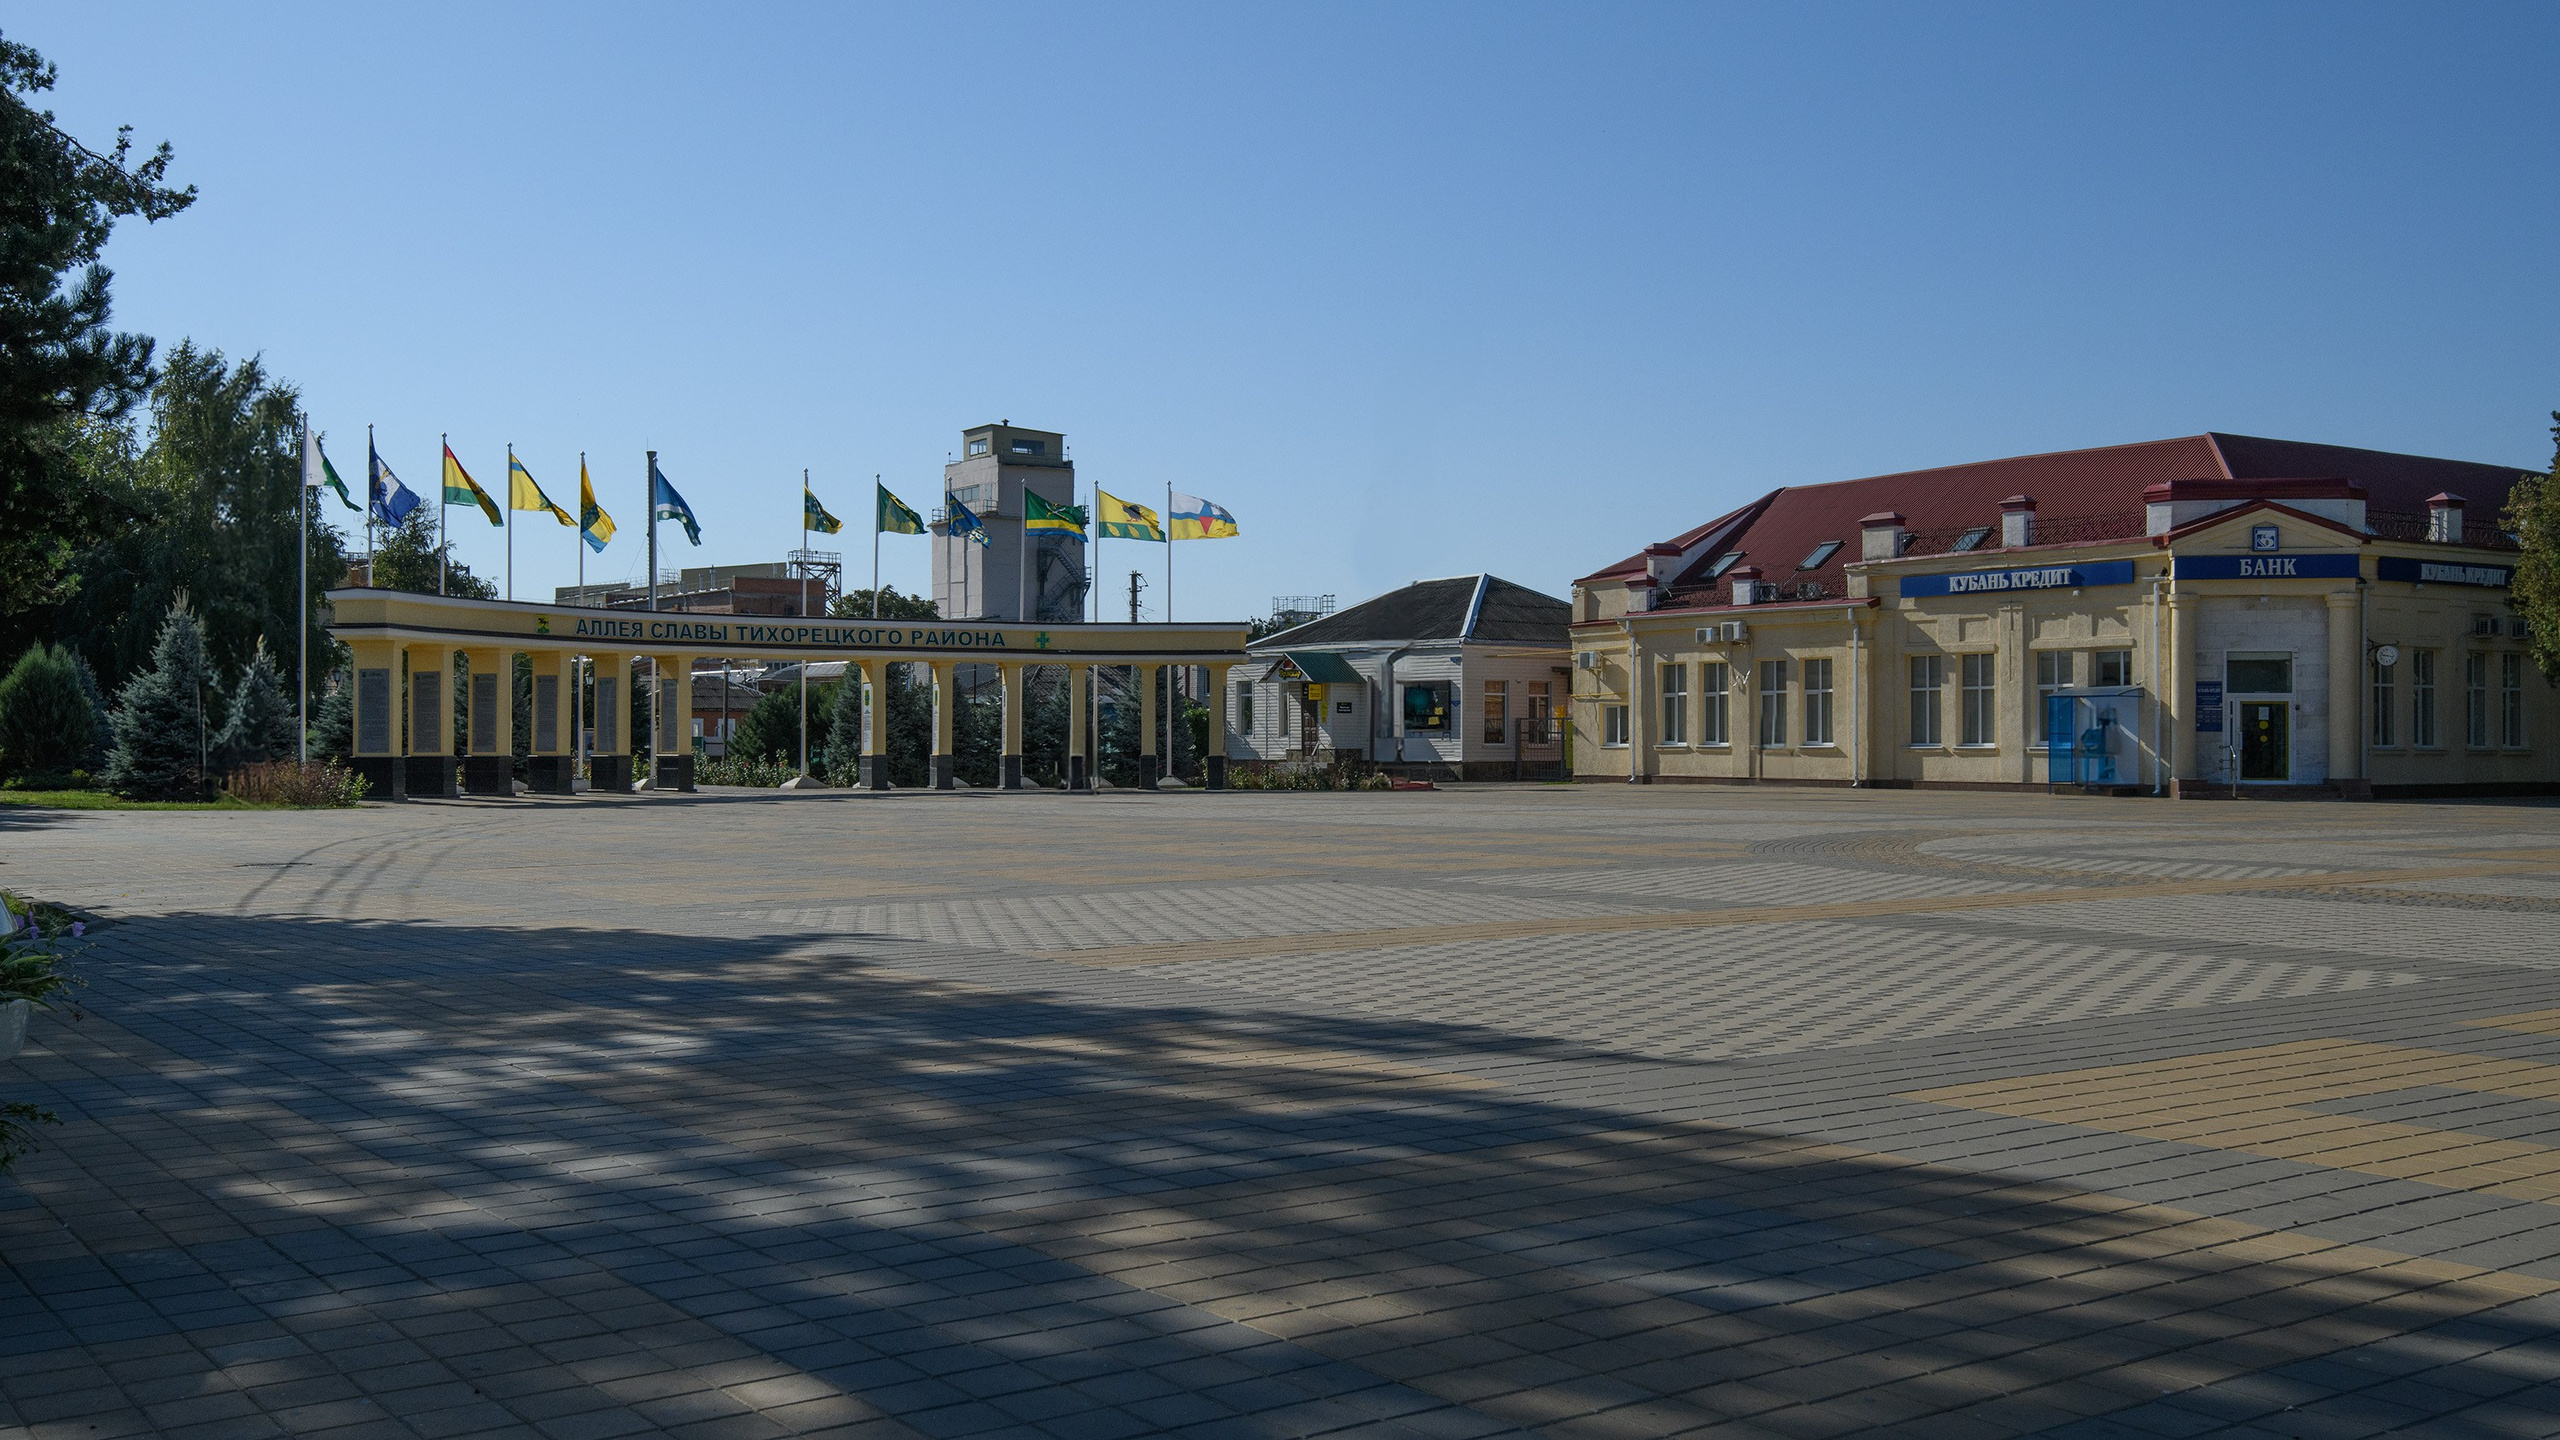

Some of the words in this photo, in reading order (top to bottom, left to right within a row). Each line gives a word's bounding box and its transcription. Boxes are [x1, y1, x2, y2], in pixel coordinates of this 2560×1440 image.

[2239, 558, 2297, 576] БАНК
[2421, 564, 2465, 582] КУБАНЬ
[1948, 573, 2009, 593] КУБАНЬ
[2011, 568, 2072, 589] КРЕДИТ
[576, 618, 644, 638] АЛЛЕЯ
[650, 622, 728, 641] СЛАВЫ
[735, 625, 903, 645] ТИХОРЕЦКОГО
[911, 629, 1006, 646] РАЙОНА
